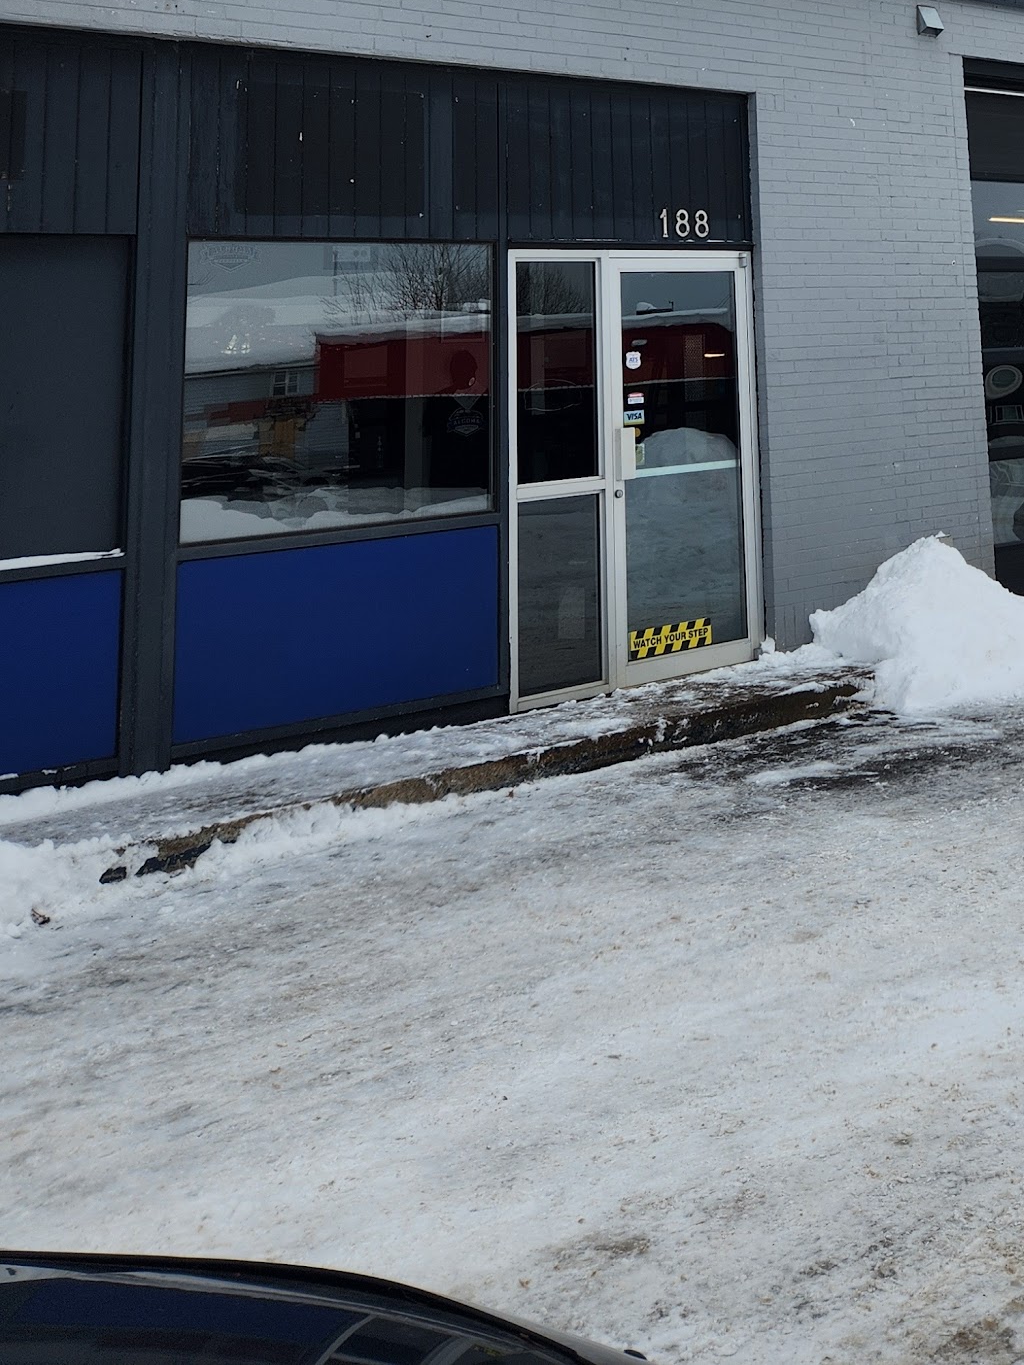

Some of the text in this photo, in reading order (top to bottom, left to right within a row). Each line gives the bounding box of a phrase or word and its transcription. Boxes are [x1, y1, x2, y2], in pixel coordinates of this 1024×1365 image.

[659, 208, 709, 238] 188
[626, 412, 643, 421] VISA
[633, 627, 708, 649] WATCH YOUR STEP
